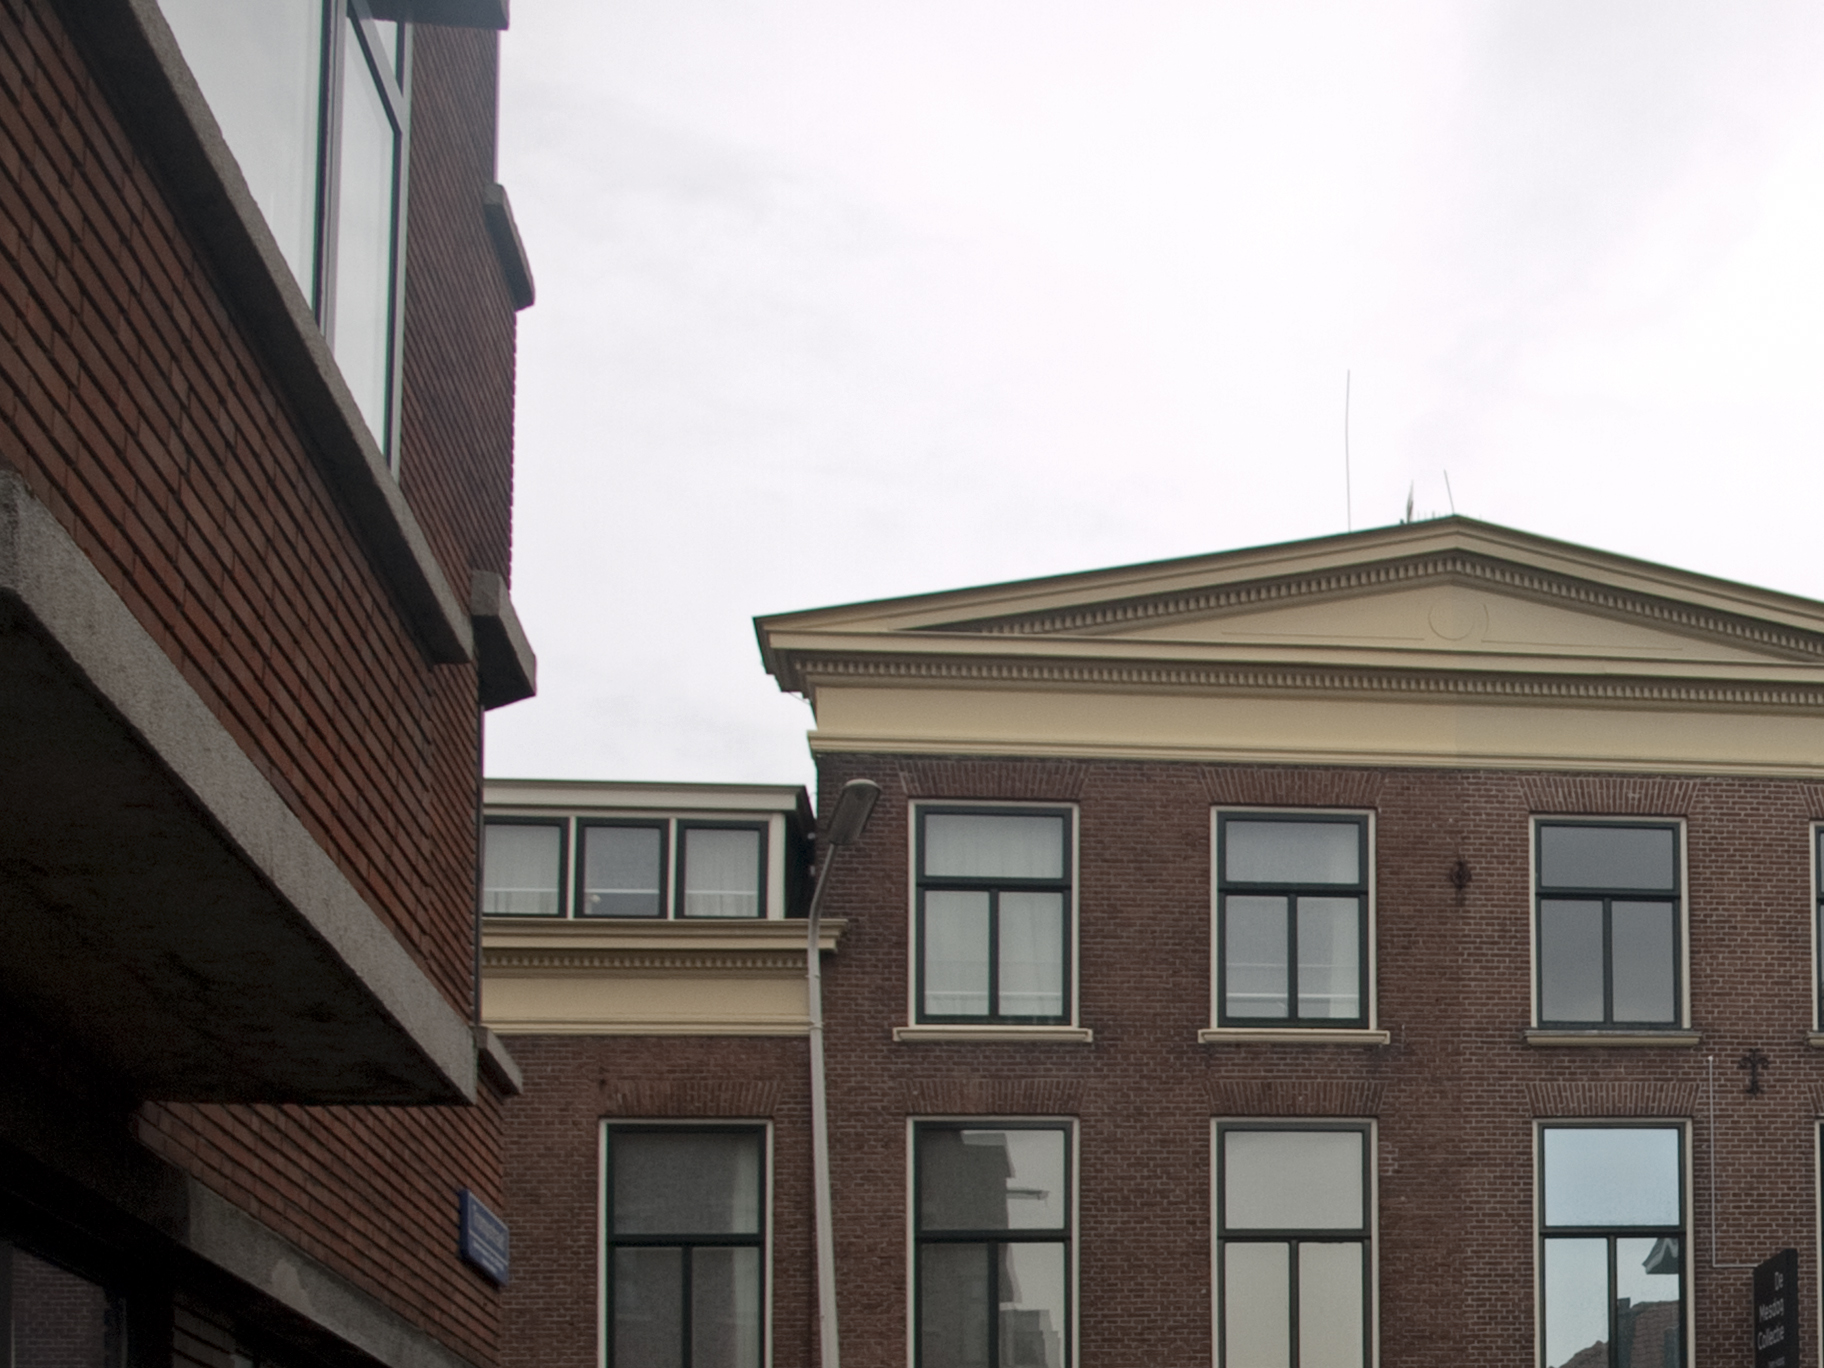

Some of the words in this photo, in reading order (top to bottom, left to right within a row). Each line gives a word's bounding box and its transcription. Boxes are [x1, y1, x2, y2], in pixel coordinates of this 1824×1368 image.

[1774, 1271, 1784, 1291] De
[1759, 1298, 1785, 1322] Mesdag
[1757, 1325, 1785, 1351] Collectie
